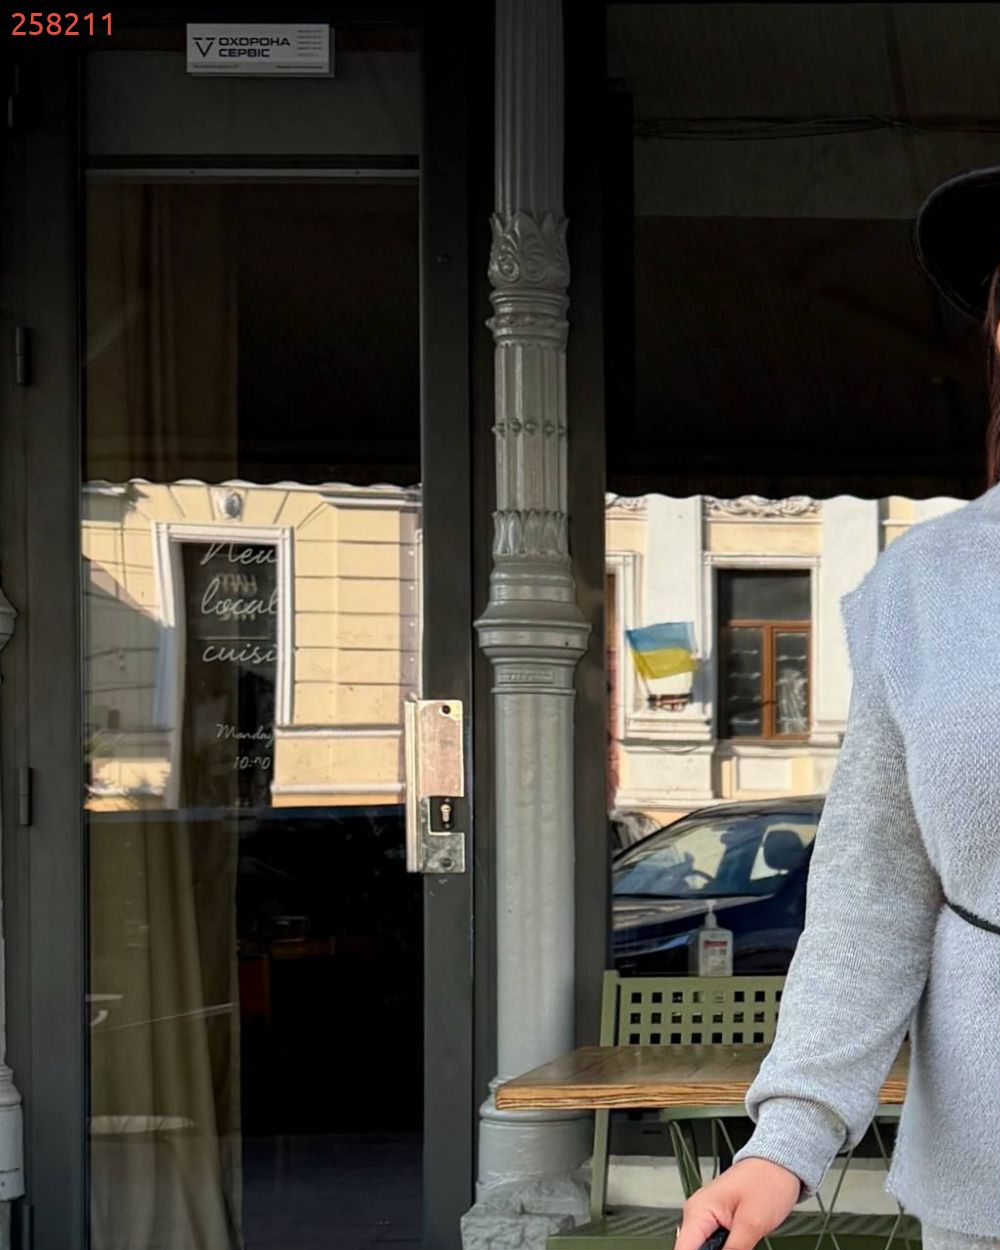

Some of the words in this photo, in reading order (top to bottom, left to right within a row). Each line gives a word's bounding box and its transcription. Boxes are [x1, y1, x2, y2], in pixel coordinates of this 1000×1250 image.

[218, 37, 291, 47] ОХОРОНА
[218, 48, 271, 58] СЕРВІС
[202, 643, 277, 664] cuisi
